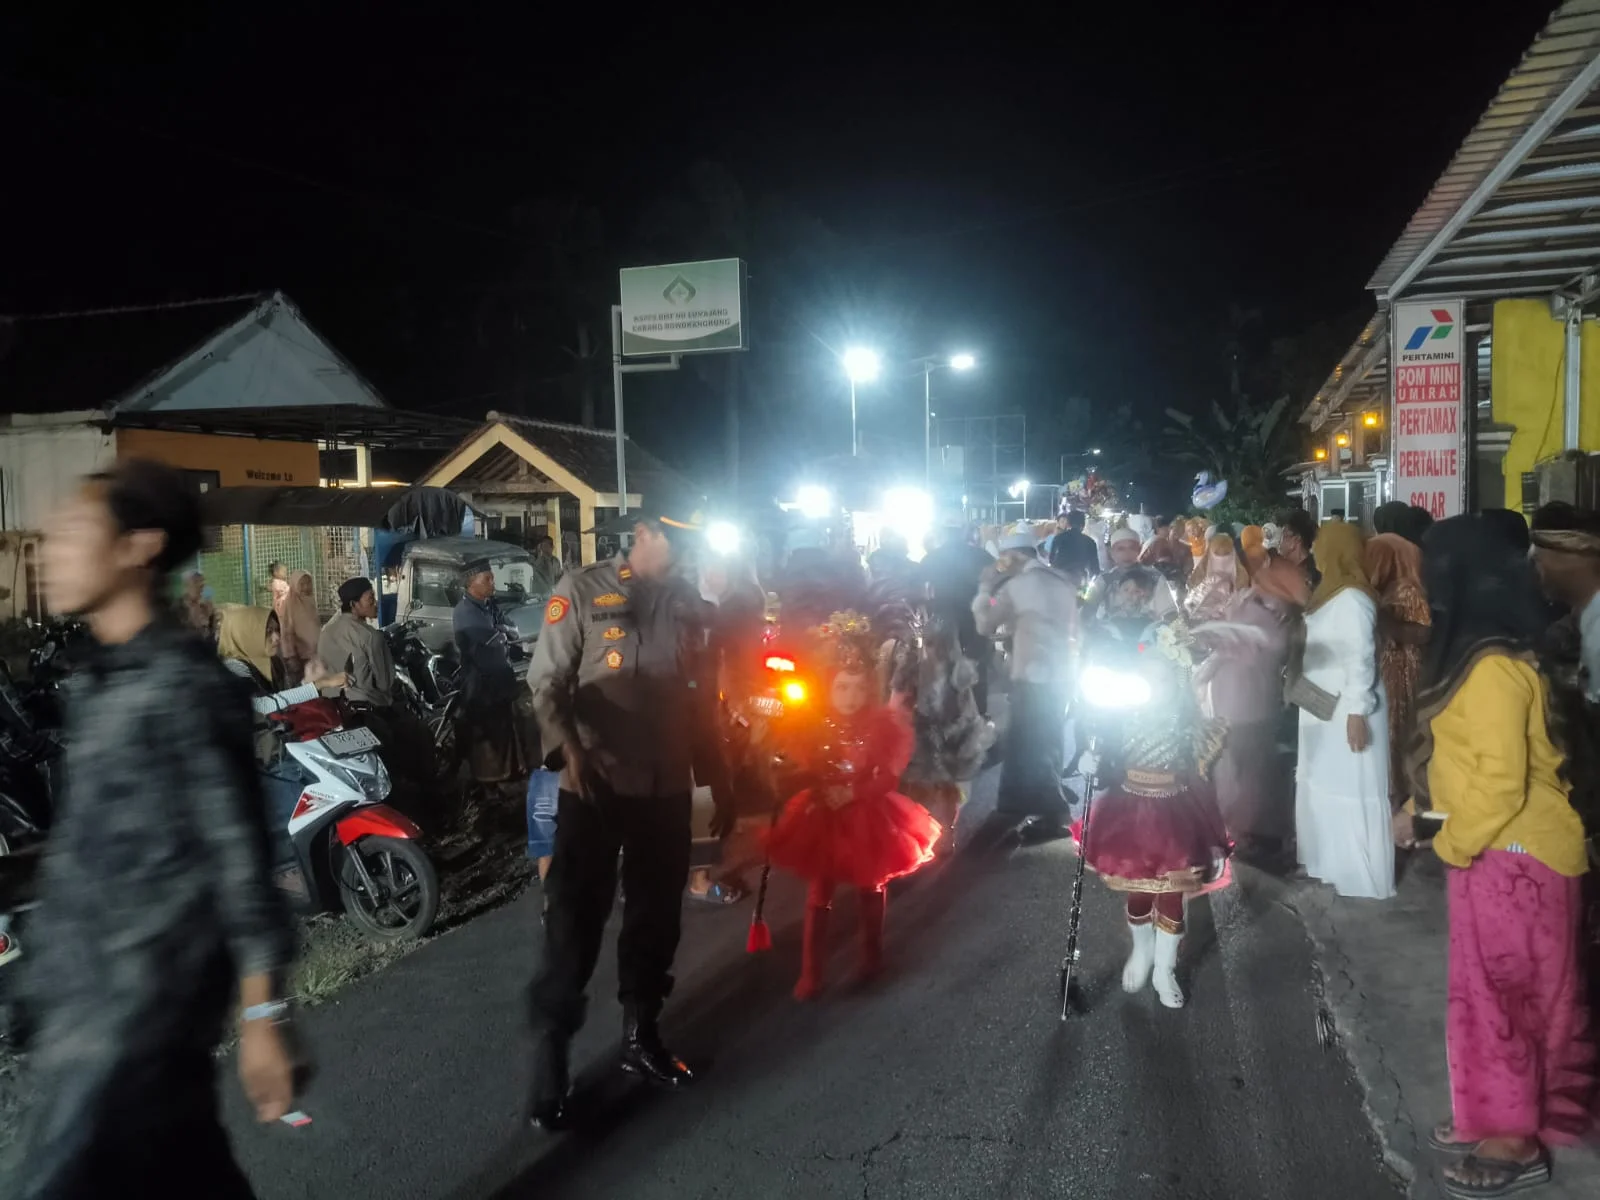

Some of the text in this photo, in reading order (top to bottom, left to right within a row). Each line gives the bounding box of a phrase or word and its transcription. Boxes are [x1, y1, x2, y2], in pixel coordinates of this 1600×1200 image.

[1402, 352, 1454, 362] PERTAMINI
[1398, 365, 1458, 387] POM MINI
[1398, 386, 1458, 401] UMIRAH
[1399, 406, 1457, 435] PERTAMAX
[1399, 449, 1456, 477] PERTALITE
